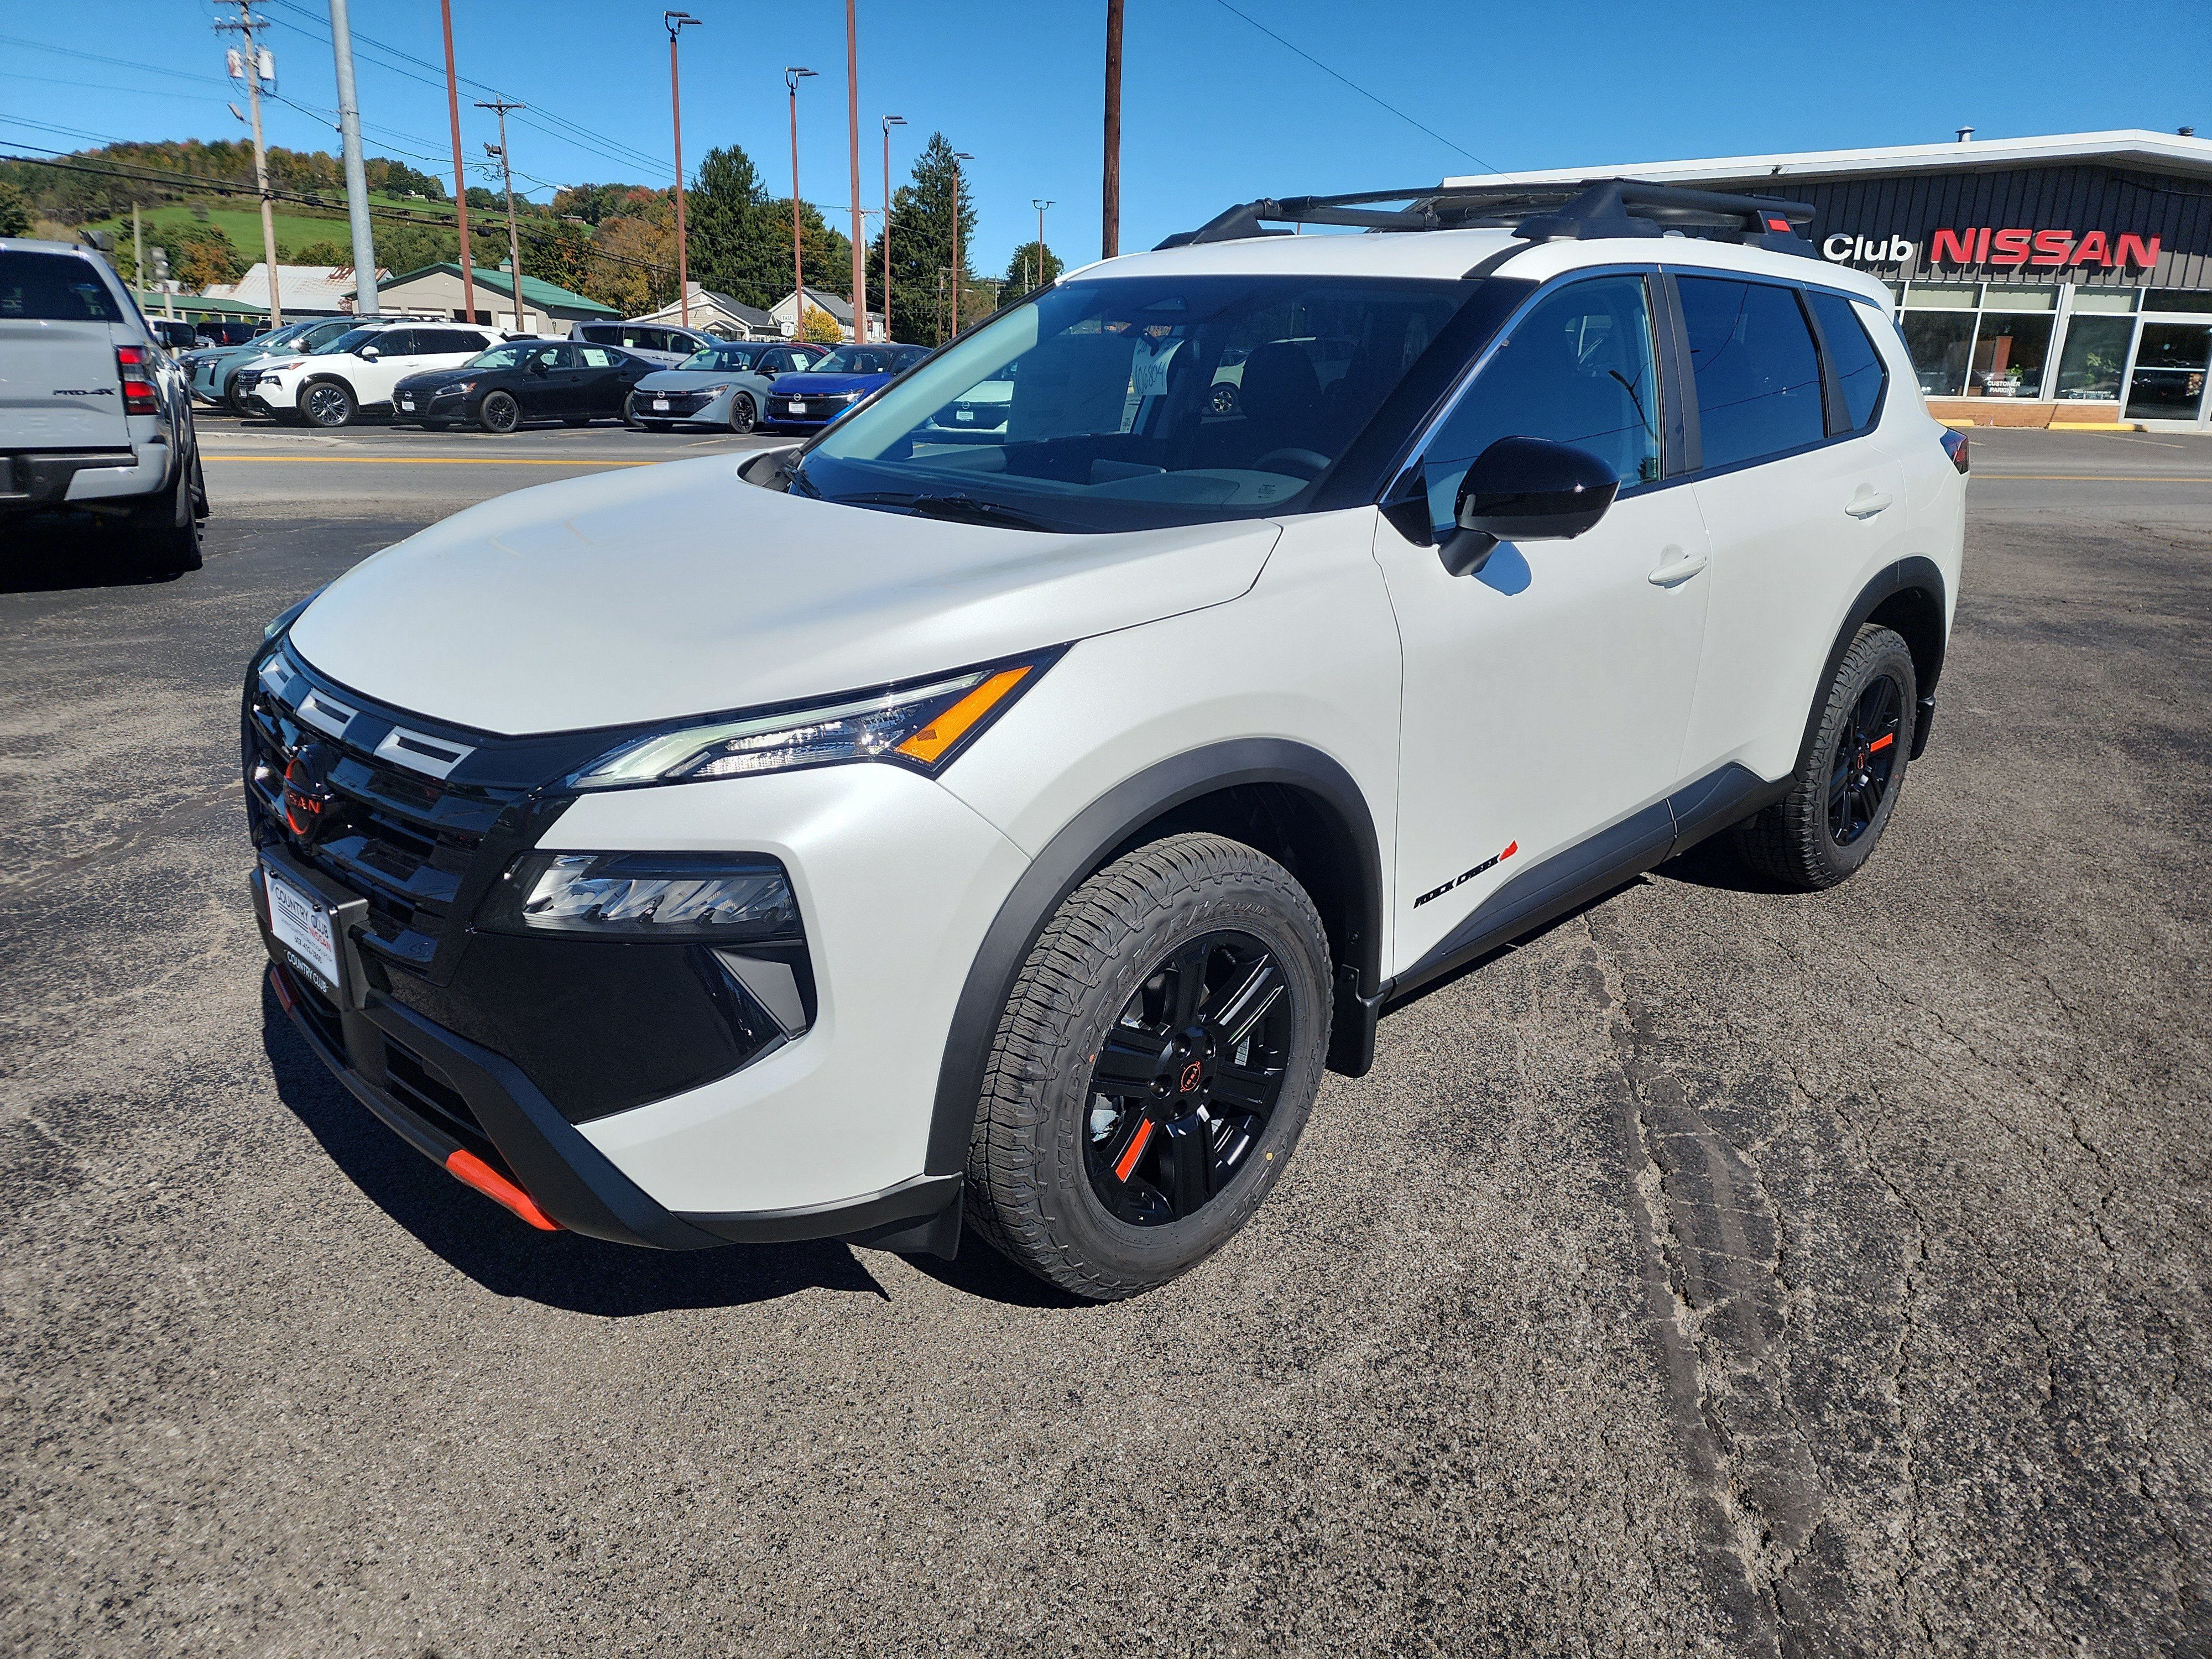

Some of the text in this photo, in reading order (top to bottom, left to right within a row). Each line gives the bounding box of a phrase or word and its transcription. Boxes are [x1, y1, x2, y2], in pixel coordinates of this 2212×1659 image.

[1823, 228, 2161, 268] Club NISSAN
[785, 325, 790, 333] 7
[1135, 361, 1166, 395] 106804
[275, 886, 329, 939] COUNTRY CLUB
[309, 925, 332, 953] NISSAN
[286, 950, 327, 993] COUNTRY CLUB
